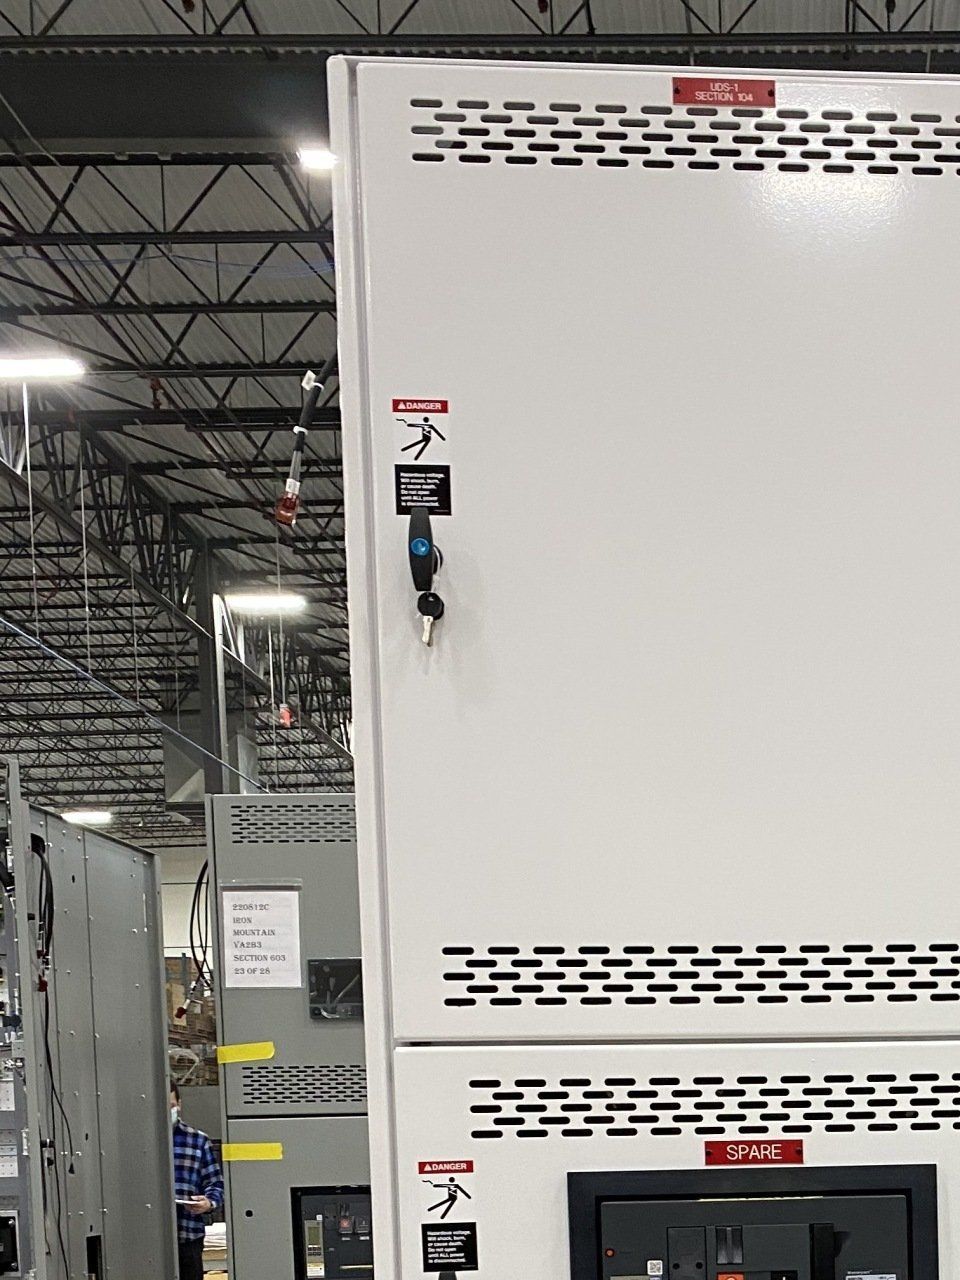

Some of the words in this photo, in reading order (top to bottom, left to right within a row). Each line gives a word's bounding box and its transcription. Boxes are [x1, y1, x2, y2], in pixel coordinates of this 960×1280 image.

[709, 82, 739, 92] UDS-1
[695, 91, 733, 102] SECTION
[737, 93, 754, 102] 104
[406, 402, 442, 410] DANGER
[233, 954, 268, 962] SECTION
[269, 954, 287, 962] 603
[234, 967, 245, 975] 23
[246, 967, 258, 975] OF
[726, 1143, 783, 1161] SPARE
[432, 1162, 467, 1171] DANGER
